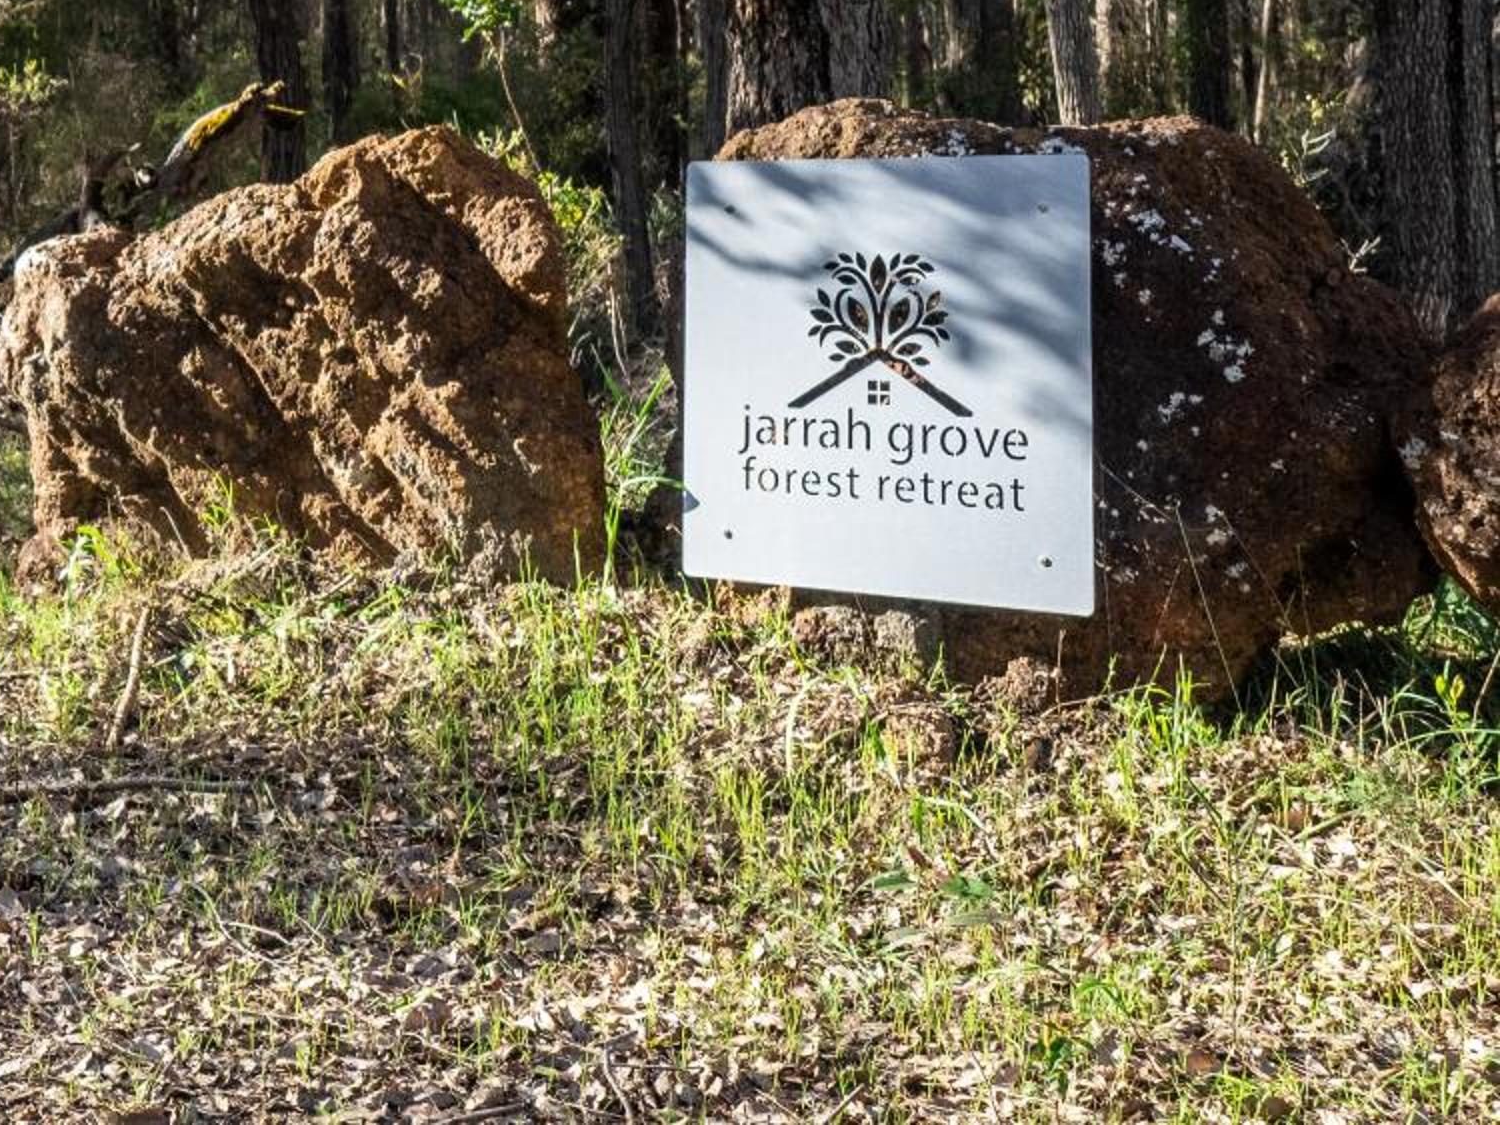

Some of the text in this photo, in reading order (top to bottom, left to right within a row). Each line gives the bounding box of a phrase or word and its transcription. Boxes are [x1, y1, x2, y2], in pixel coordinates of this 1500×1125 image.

[738, 404, 1029, 465] jarrah grove
[742, 456, 1026, 512] forest retreat
